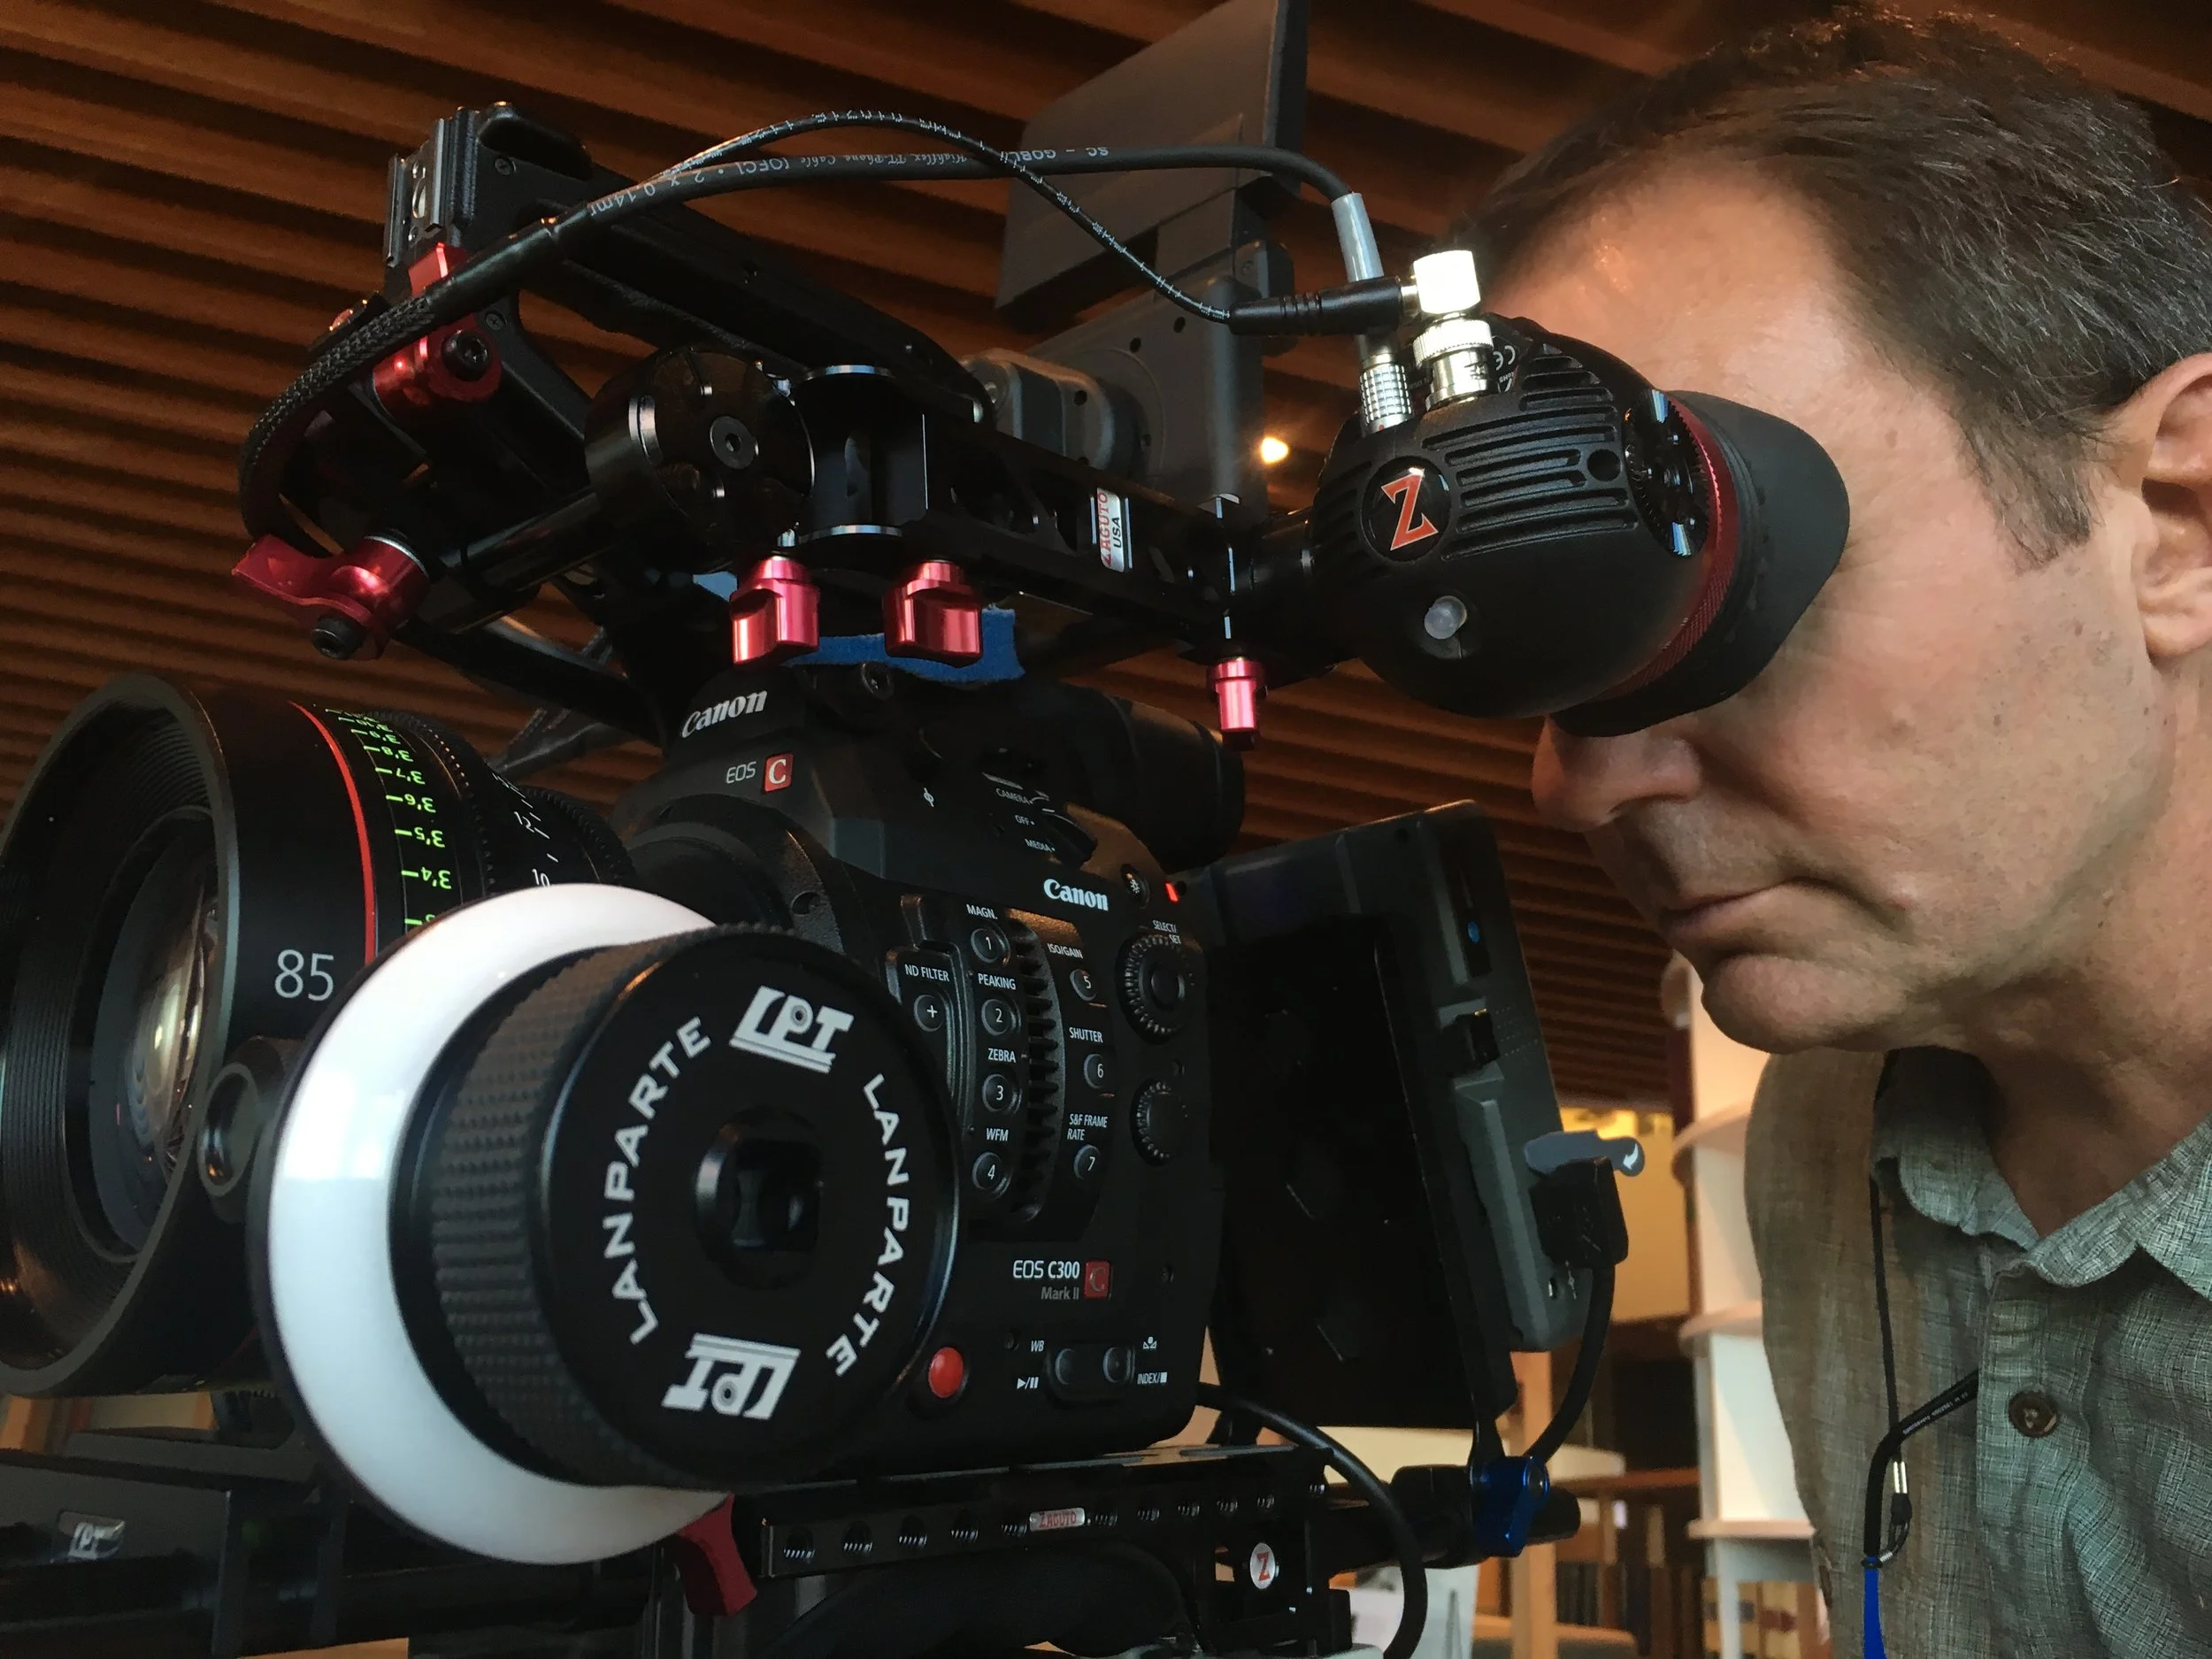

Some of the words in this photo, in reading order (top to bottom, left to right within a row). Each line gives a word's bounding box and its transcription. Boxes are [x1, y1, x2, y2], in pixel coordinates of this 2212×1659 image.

[1086, 146, 1110, 157] SC
[800, 155, 836, 168] Cable
[693, 170, 706, 183] 2
[1381, 468, 1439, 551] Z
[1111, 517, 1122, 549] USA
[681, 690, 768, 738] Canon
[396, 767, 426, 785] 3'7
[726, 761, 757, 784] EOS
[769, 758, 787, 784] C
[404, 793, 436, 813] 3'6
[514, 810, 534, 833] 12
[414, 826, 445, 849] 3'5
[421, 866, 452, 889] 3'4
[1043, 879, 1109, 911] Canon
[965, 903, 998, 919] MAGN.
[985, 936, 992, 950] 1
[1048, 942, 1084, 959] ISO/GAIN
[274, 949, 334, 1002] 85
[904, 964, 919, 977] ND
[920, 966, 949, 982] FILTER
[978, 972, 1017, 990] PEAKING
[1083, 975, 1092, 989] 5
[995, 1008, 1003, 1023] 2
[1069, 1026, 1103, 1043] SHUTTER
[987, 1048, 1017, 1063] ZEBRA
[1097, 1064, 1104, 1078] 6
[995, 1085, 1003, 1101] 3
[1084, 1114, 1108, 1128] FRAME
[987, 1127, 1009, 1141] WFM
[1067, 1128, 1086, 1141] RATE
[987, 1164, 995, 1180] 4
[1087, 1156, 1095, 1171] 7
[603, 1016, 711, 1344] LANPARTE
[826, 1073, 910, 1376] LANPARTE
[1012, 1260, 1044, 1279] EOS
[1048, 1261, 1080, 1279] C300
[1041, 1286, 1070, 1301] Mark
[1030, 1340, 1045, 1352] WB
[1256, 1552, 1271, 1582] Z
